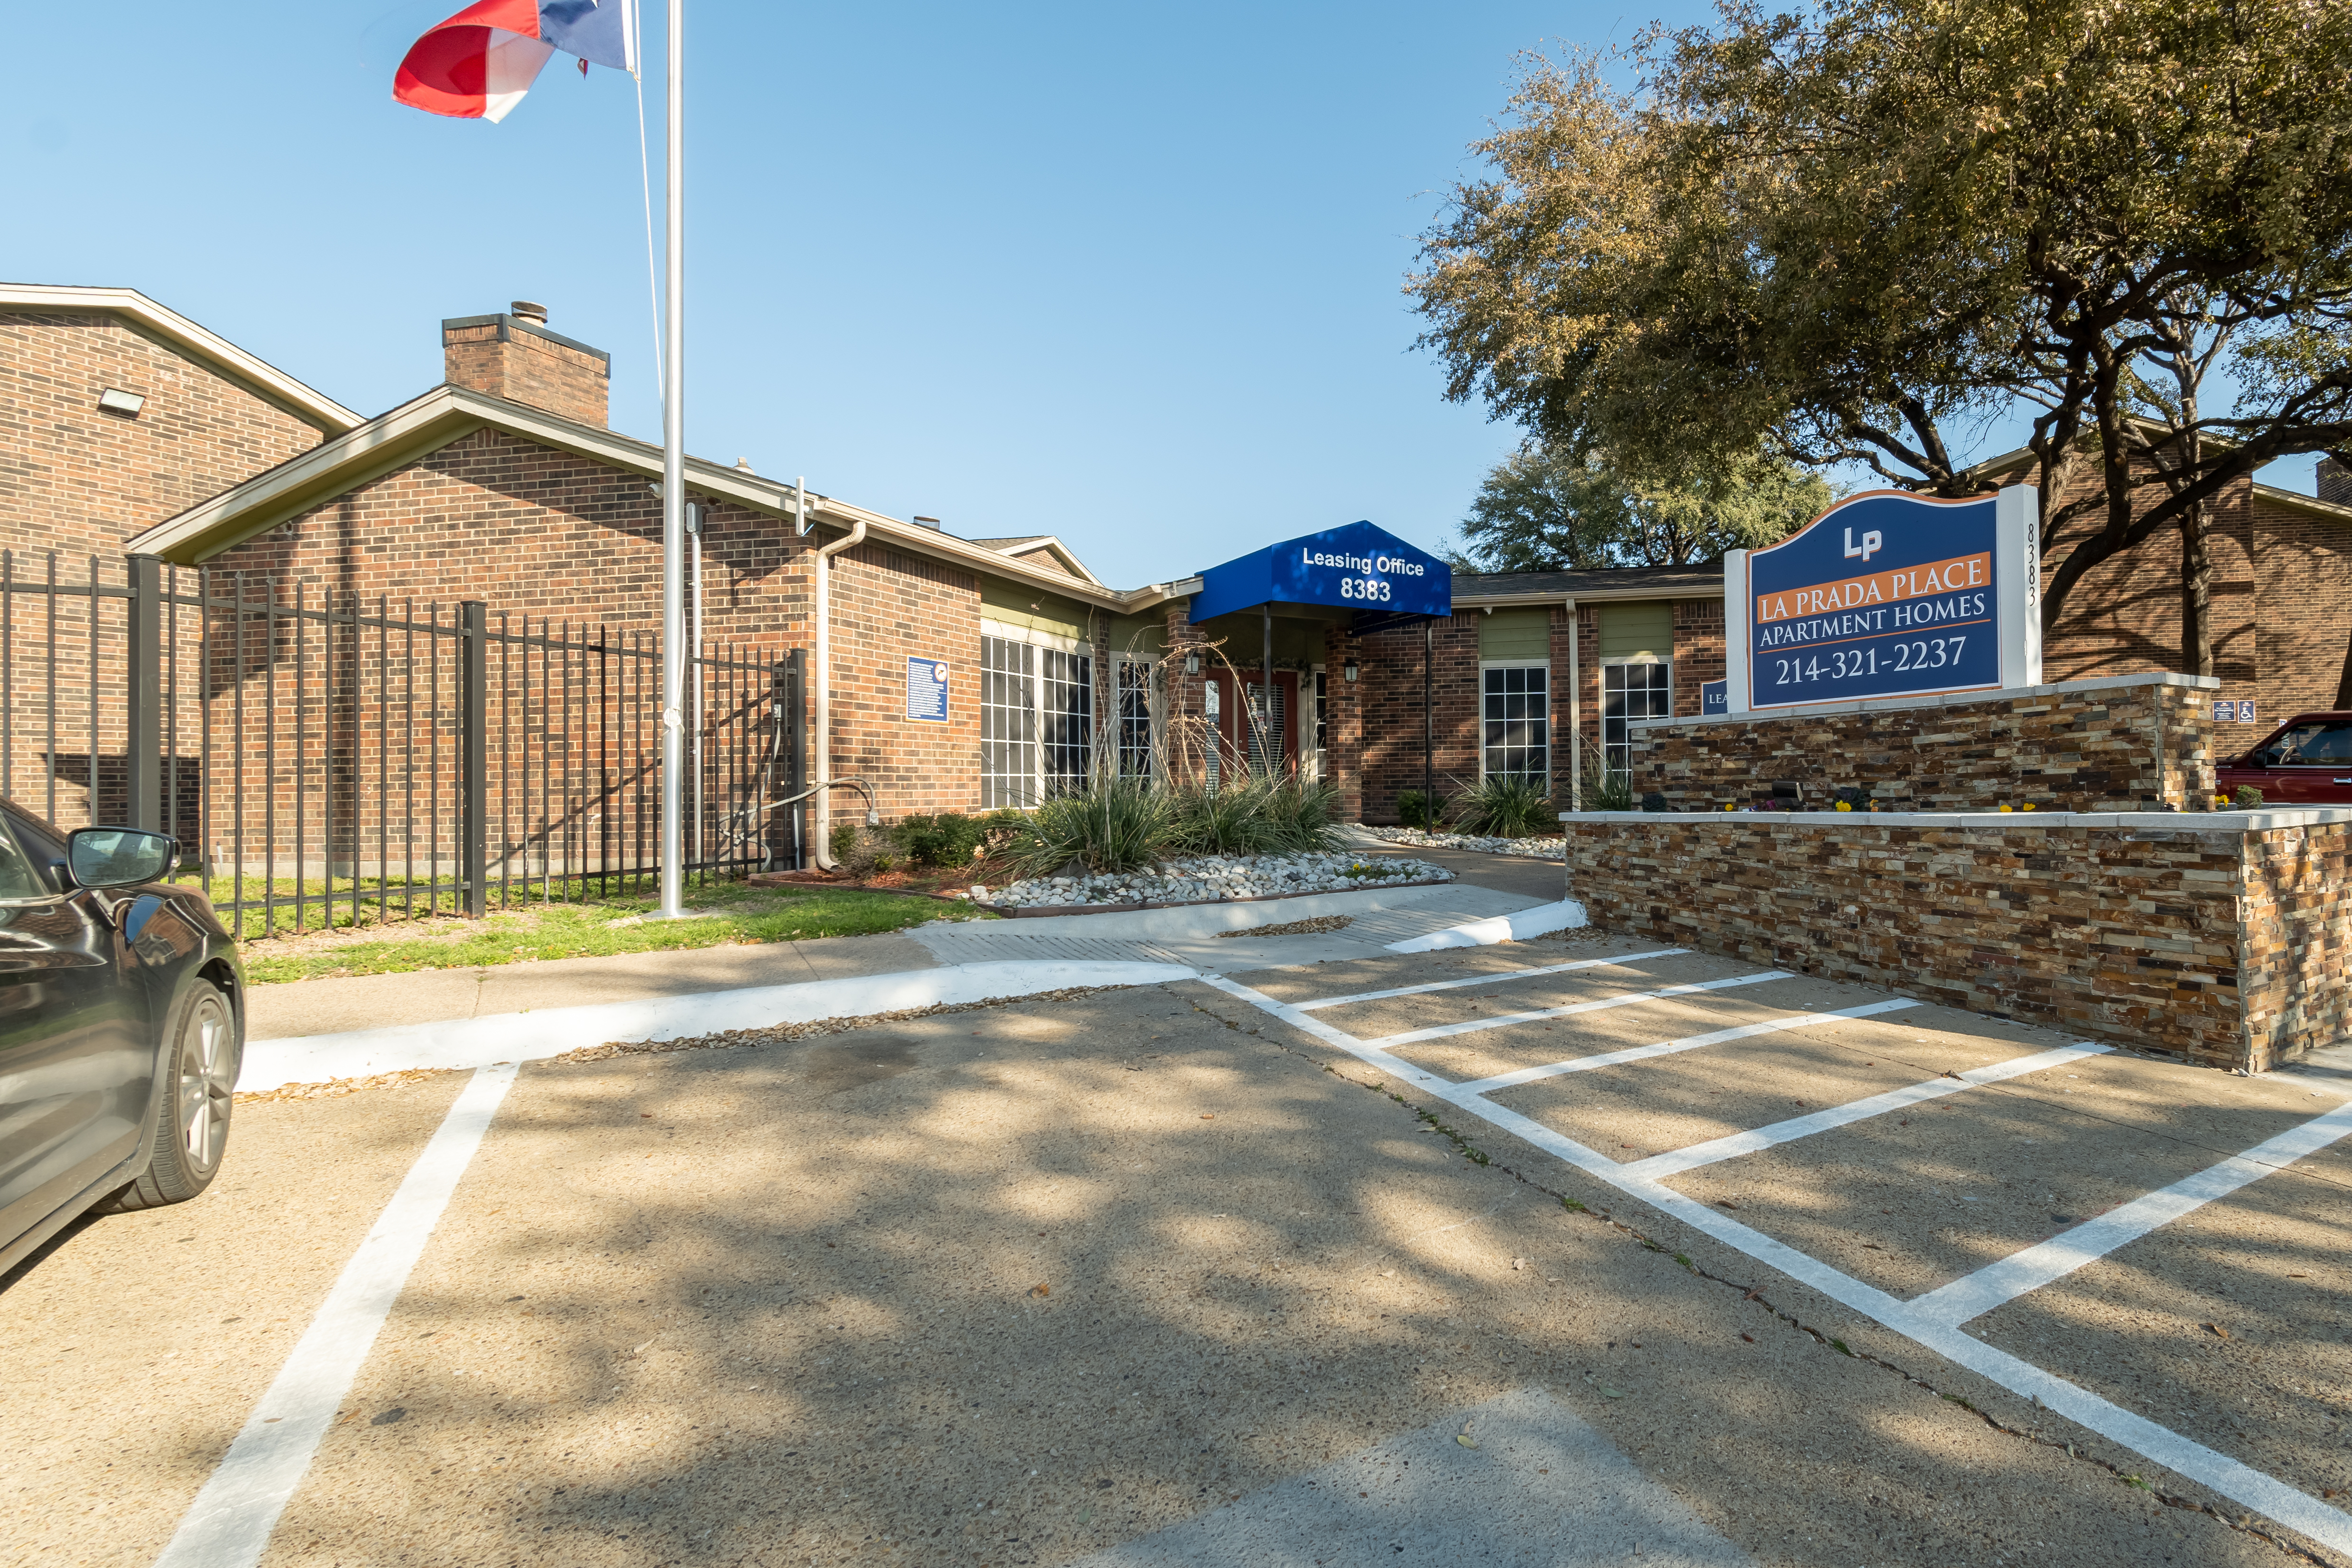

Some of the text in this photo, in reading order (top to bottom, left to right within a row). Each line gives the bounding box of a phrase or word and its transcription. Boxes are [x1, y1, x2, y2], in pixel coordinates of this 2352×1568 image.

[1303, 547, 1424, 576] Leasing Office
[1844, 527, 1882, 562] LP
[1341, 577, 1390, 602] 8383
[1761, 559, 1982, 621] LA PRADA PLACE
[1759, 594, 1984, 647] APARTMENT HOMES
[1776, 636, 1966, 685] 214-321-2237
